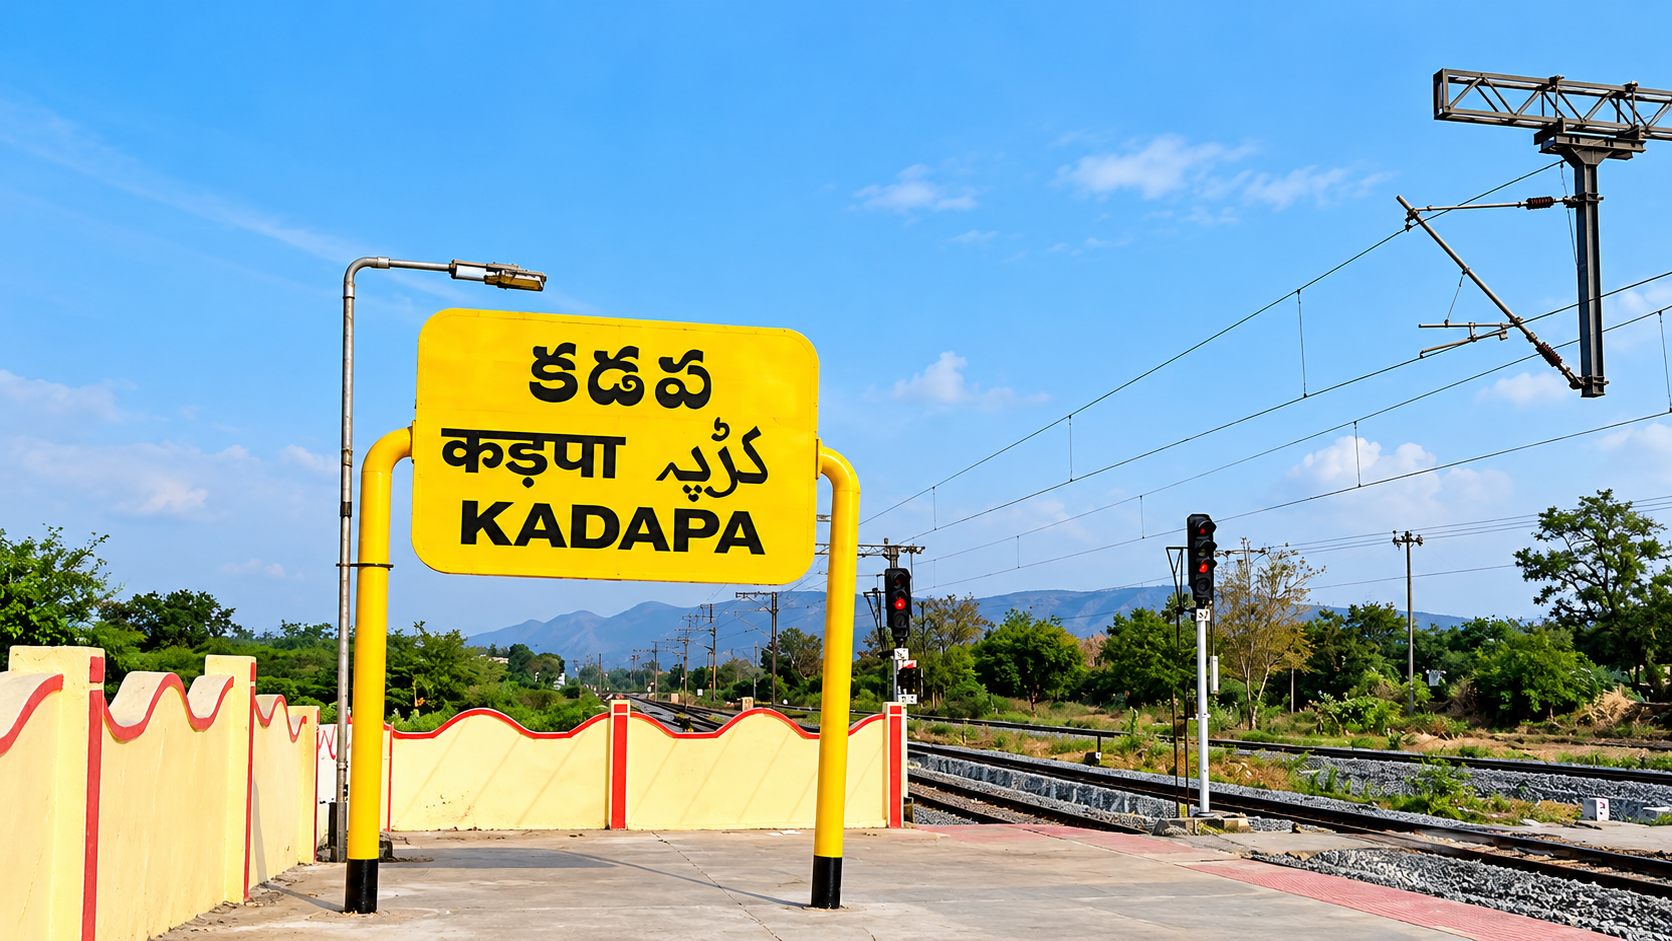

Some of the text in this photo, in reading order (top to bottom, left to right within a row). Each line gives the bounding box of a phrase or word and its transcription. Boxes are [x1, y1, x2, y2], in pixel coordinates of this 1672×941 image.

[529, 342, 712, 410] కడప
[440, 427, 627, 489] कड़पा
[460, 499, 766, 556] KADAPA
